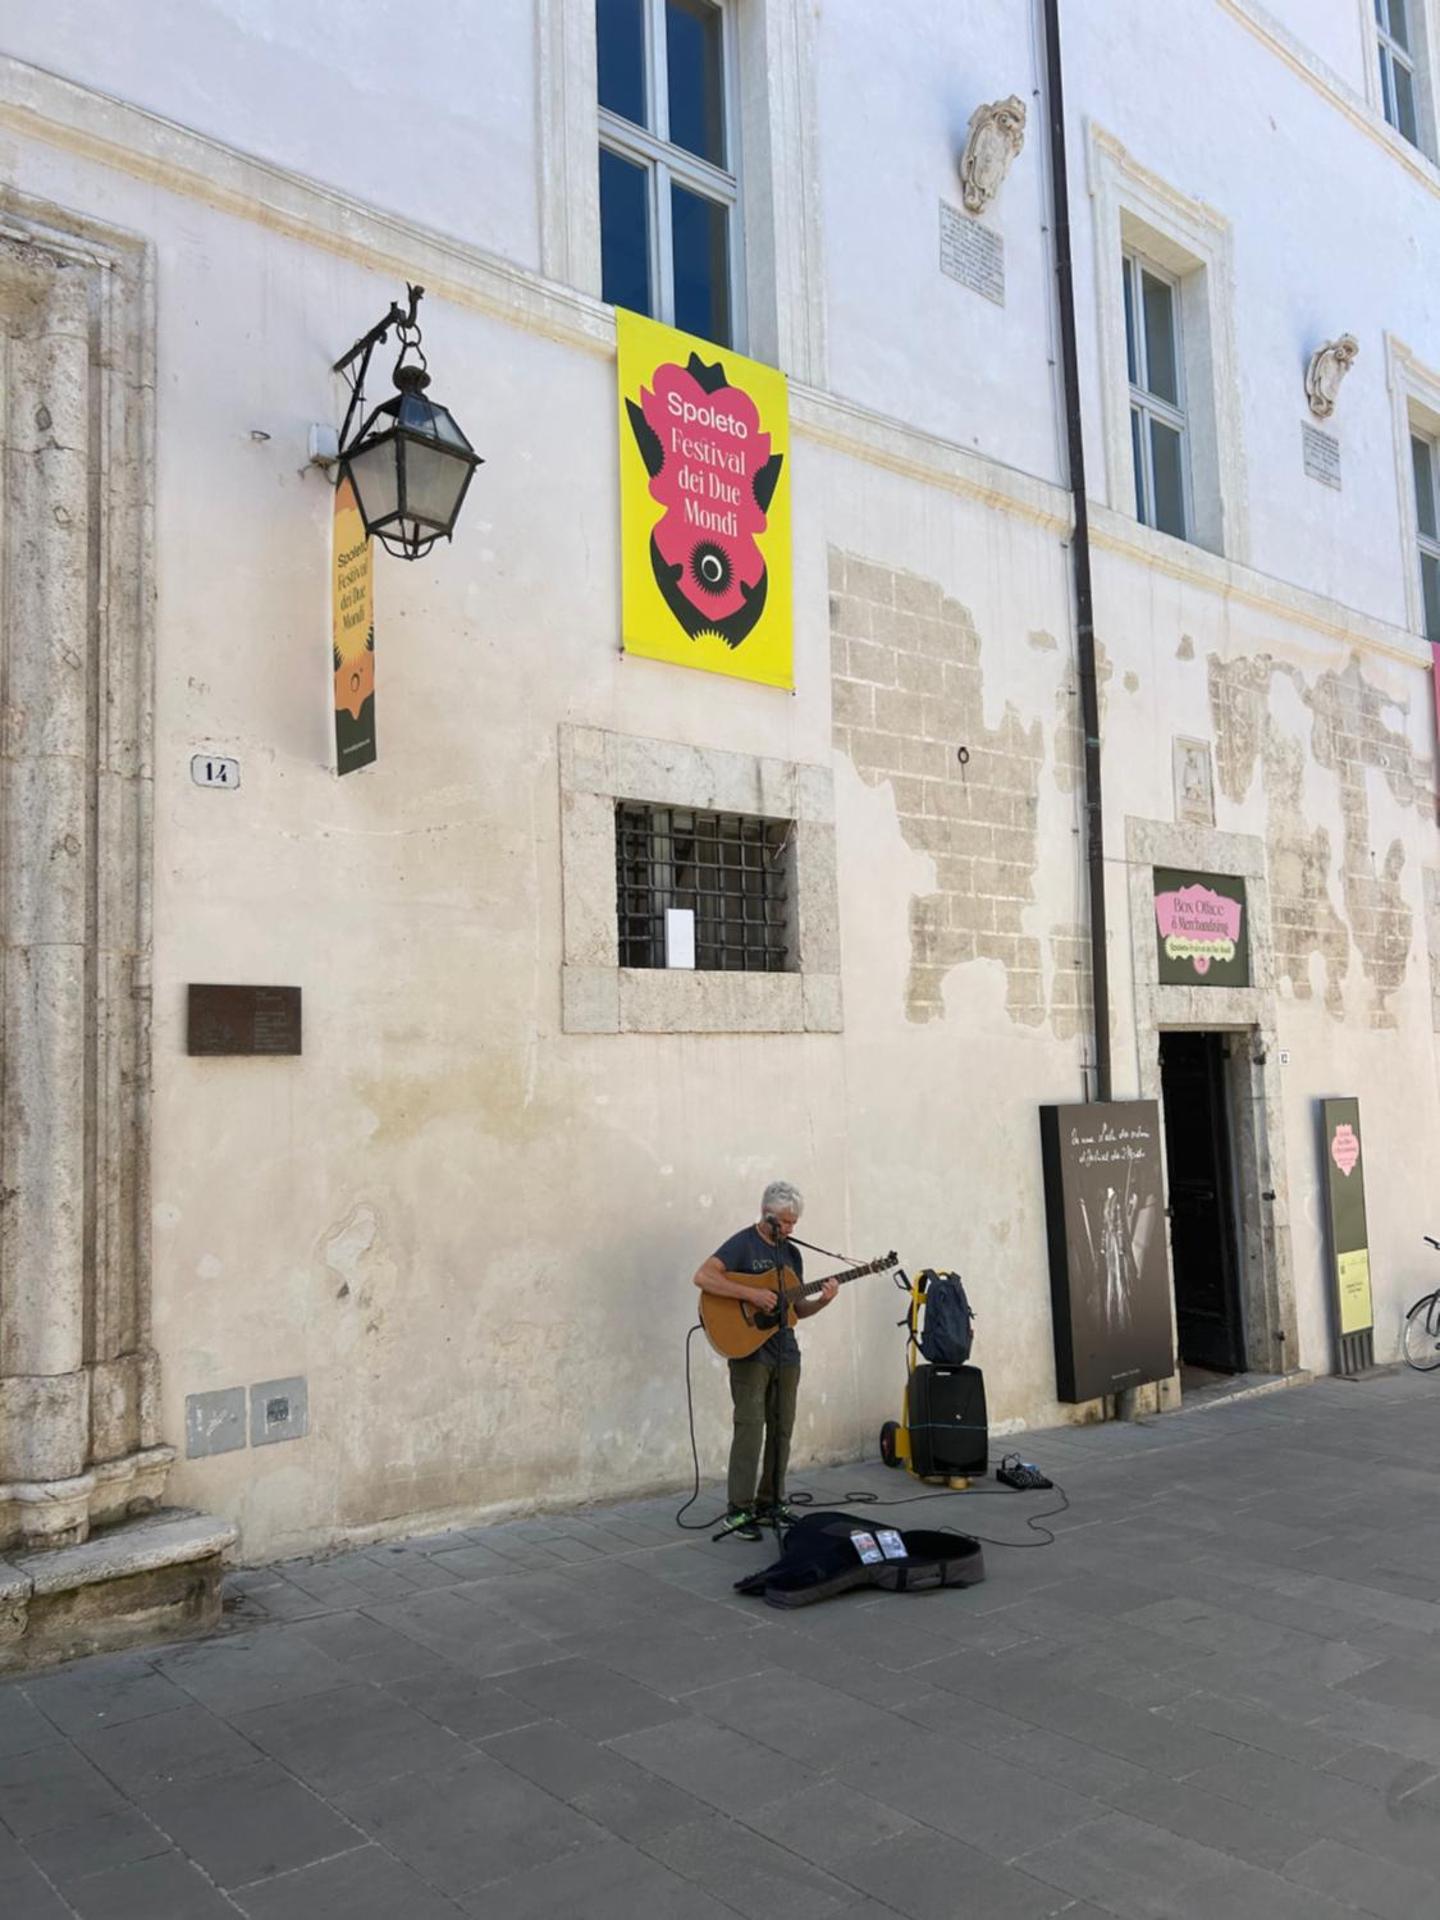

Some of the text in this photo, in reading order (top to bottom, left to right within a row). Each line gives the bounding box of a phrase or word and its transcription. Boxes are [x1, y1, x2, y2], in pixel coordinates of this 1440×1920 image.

[667, 391, 748, 440] Spoleto
[671, 427, 746, 476] Festival
[678, 464, 741, 506] dei Due
[684, 498, 738, 537] Mondi
[206, 762, 227, 782] 14
[1173, 897, 1225, 916] Box Office
